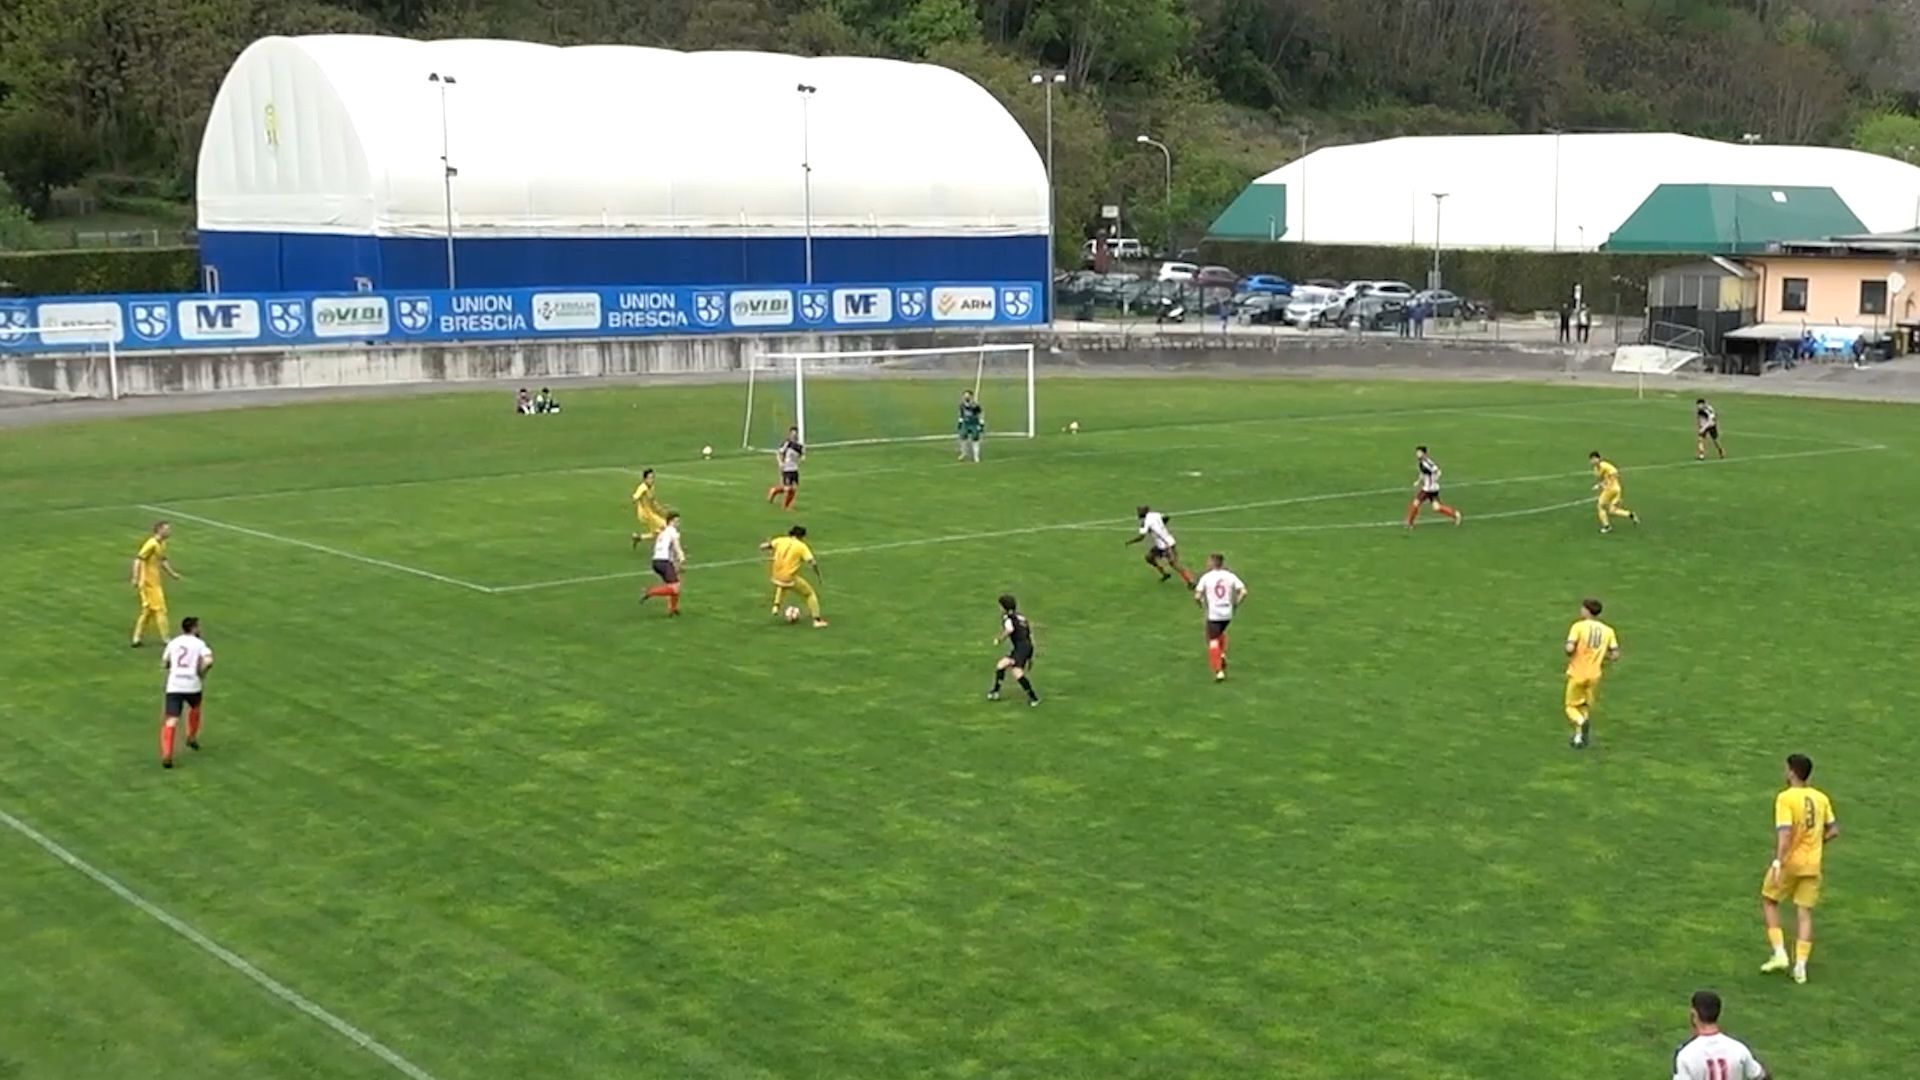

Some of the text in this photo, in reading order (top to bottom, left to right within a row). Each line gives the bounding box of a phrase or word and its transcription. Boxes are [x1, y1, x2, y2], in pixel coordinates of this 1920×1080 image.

[452, 295, 513, 313] UNION
[619, 293, 675, 309] UNION
[845, 294, 878, 315] MF
[960, 299, 992, 311] ARM
[195, 304, 241, 329] MF
[440, 314, 527, 332] BRESCIA
[608, 311, 688, 328] BRESCIA
[1214, 579, 1226, 600] 6
[1587, 625, 1602, 649] 10
[177, 645, 190, 668] 2
[1706, 1058, 1728, 1080] 11
